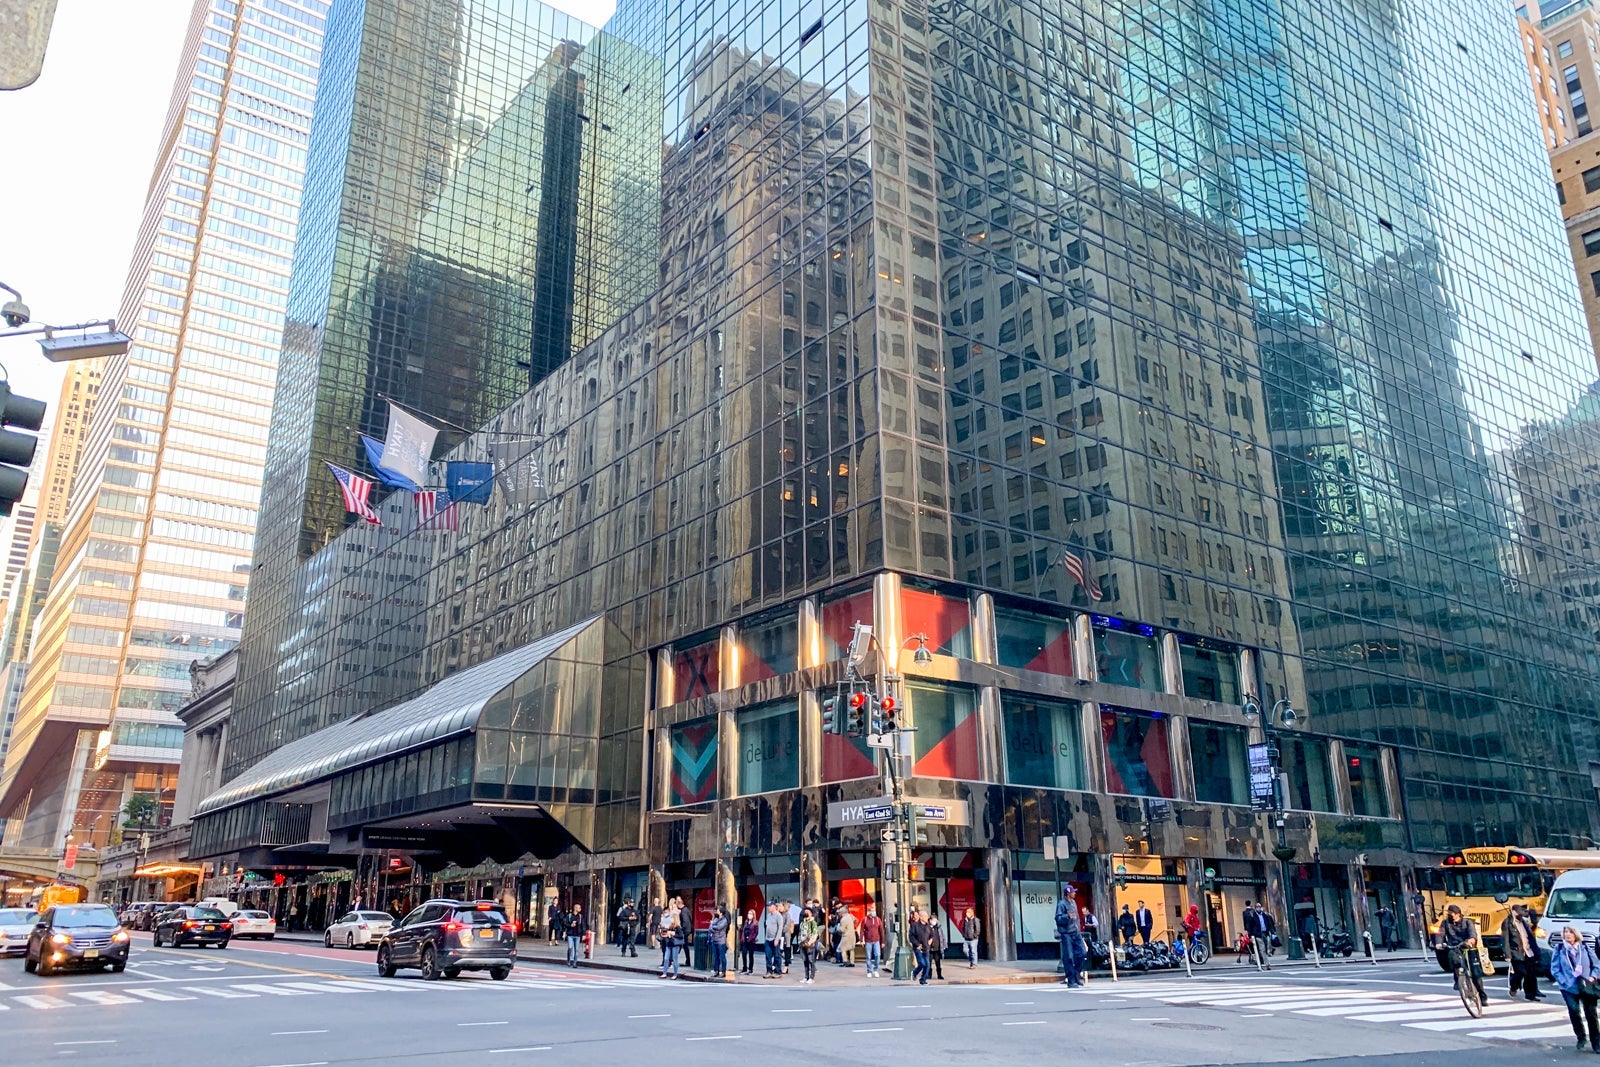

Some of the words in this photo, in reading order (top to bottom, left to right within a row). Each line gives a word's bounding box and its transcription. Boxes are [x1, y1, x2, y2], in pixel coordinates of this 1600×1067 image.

[387, 419, 404, 457] HYATT
[1012, 730, 1068, 757] deluxe
[746, 741, 793, 764] deluxe
[865, 811, 875, 819] East
[875, 810, 886, 818] 42nd
[1467, 852, 1490, 863] SCHOOL
[1492, 852, 1505, 863] BUS
[1025, 893, 1053, 905] deluxe
